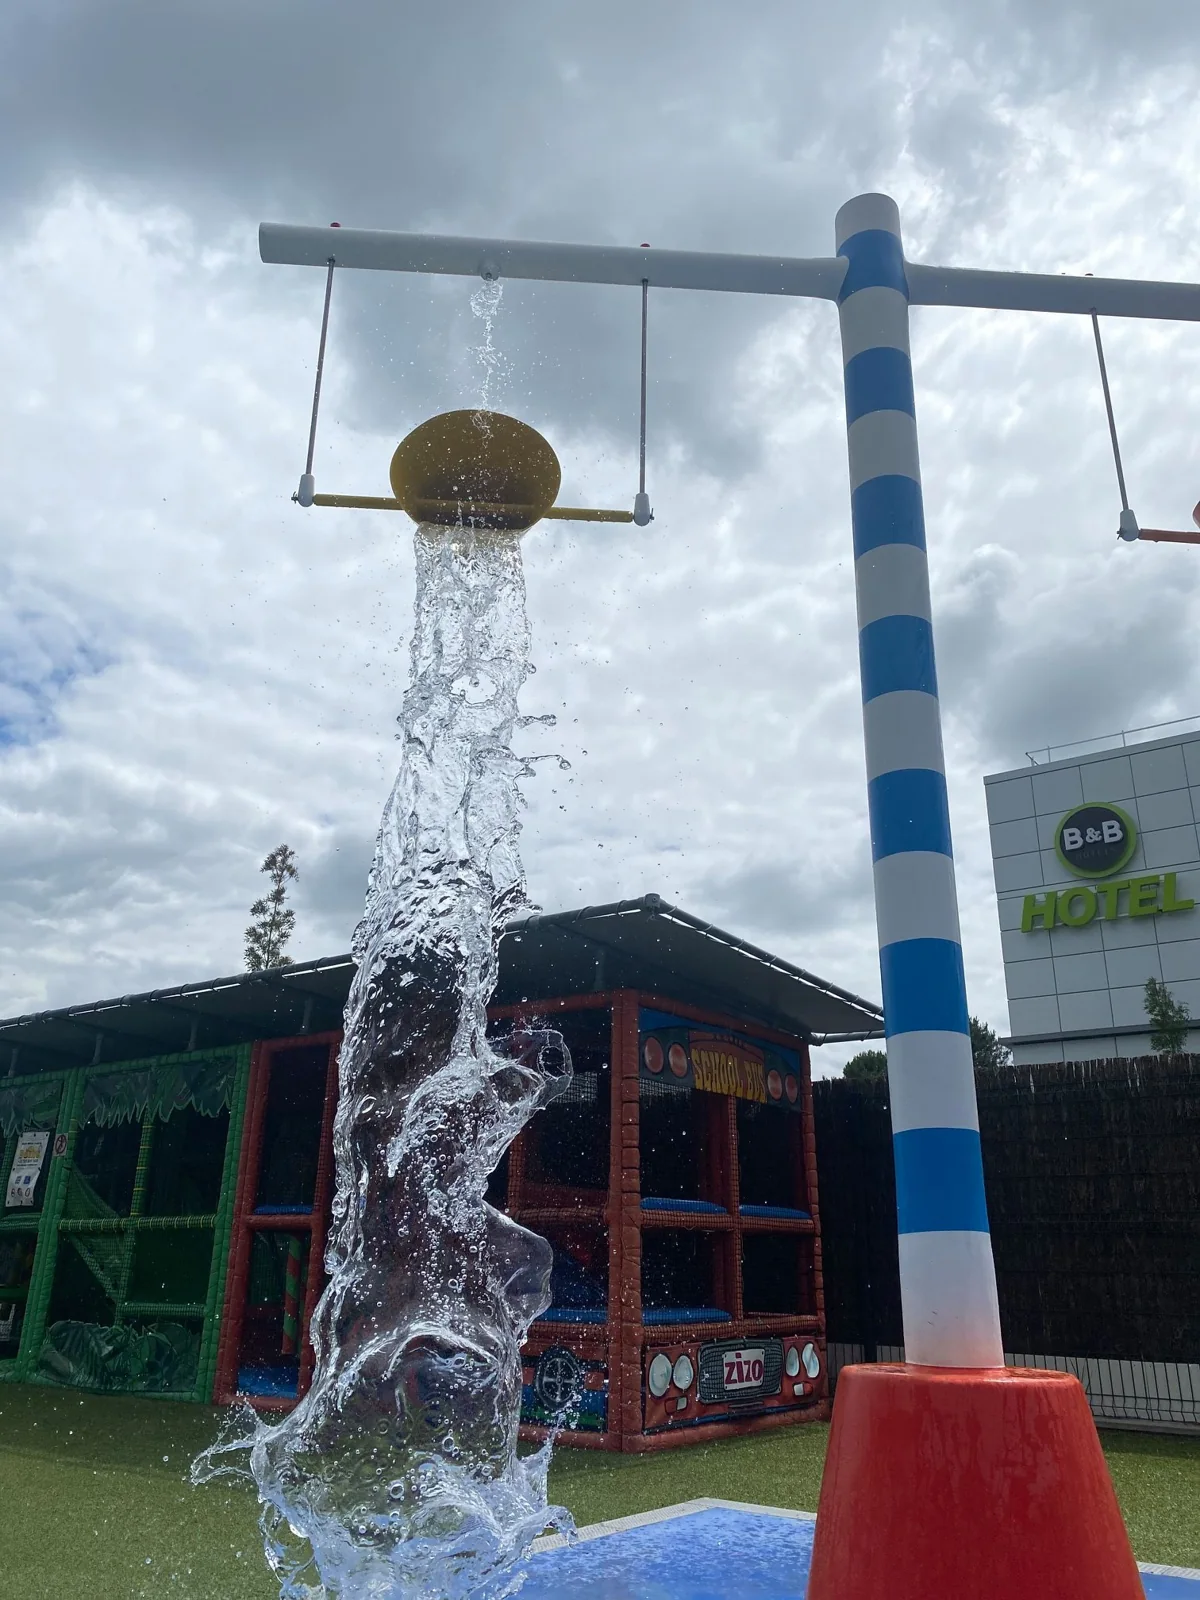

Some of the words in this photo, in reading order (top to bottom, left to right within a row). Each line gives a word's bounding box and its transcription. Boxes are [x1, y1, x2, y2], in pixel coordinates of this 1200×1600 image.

[1063, 820, 1124, 850] B&B
[1021, 872, 1195, 933] HOTEL
[691, 1048, 744, 1097] SCHOOL
[743, 1060, 768, 1104] BUS
